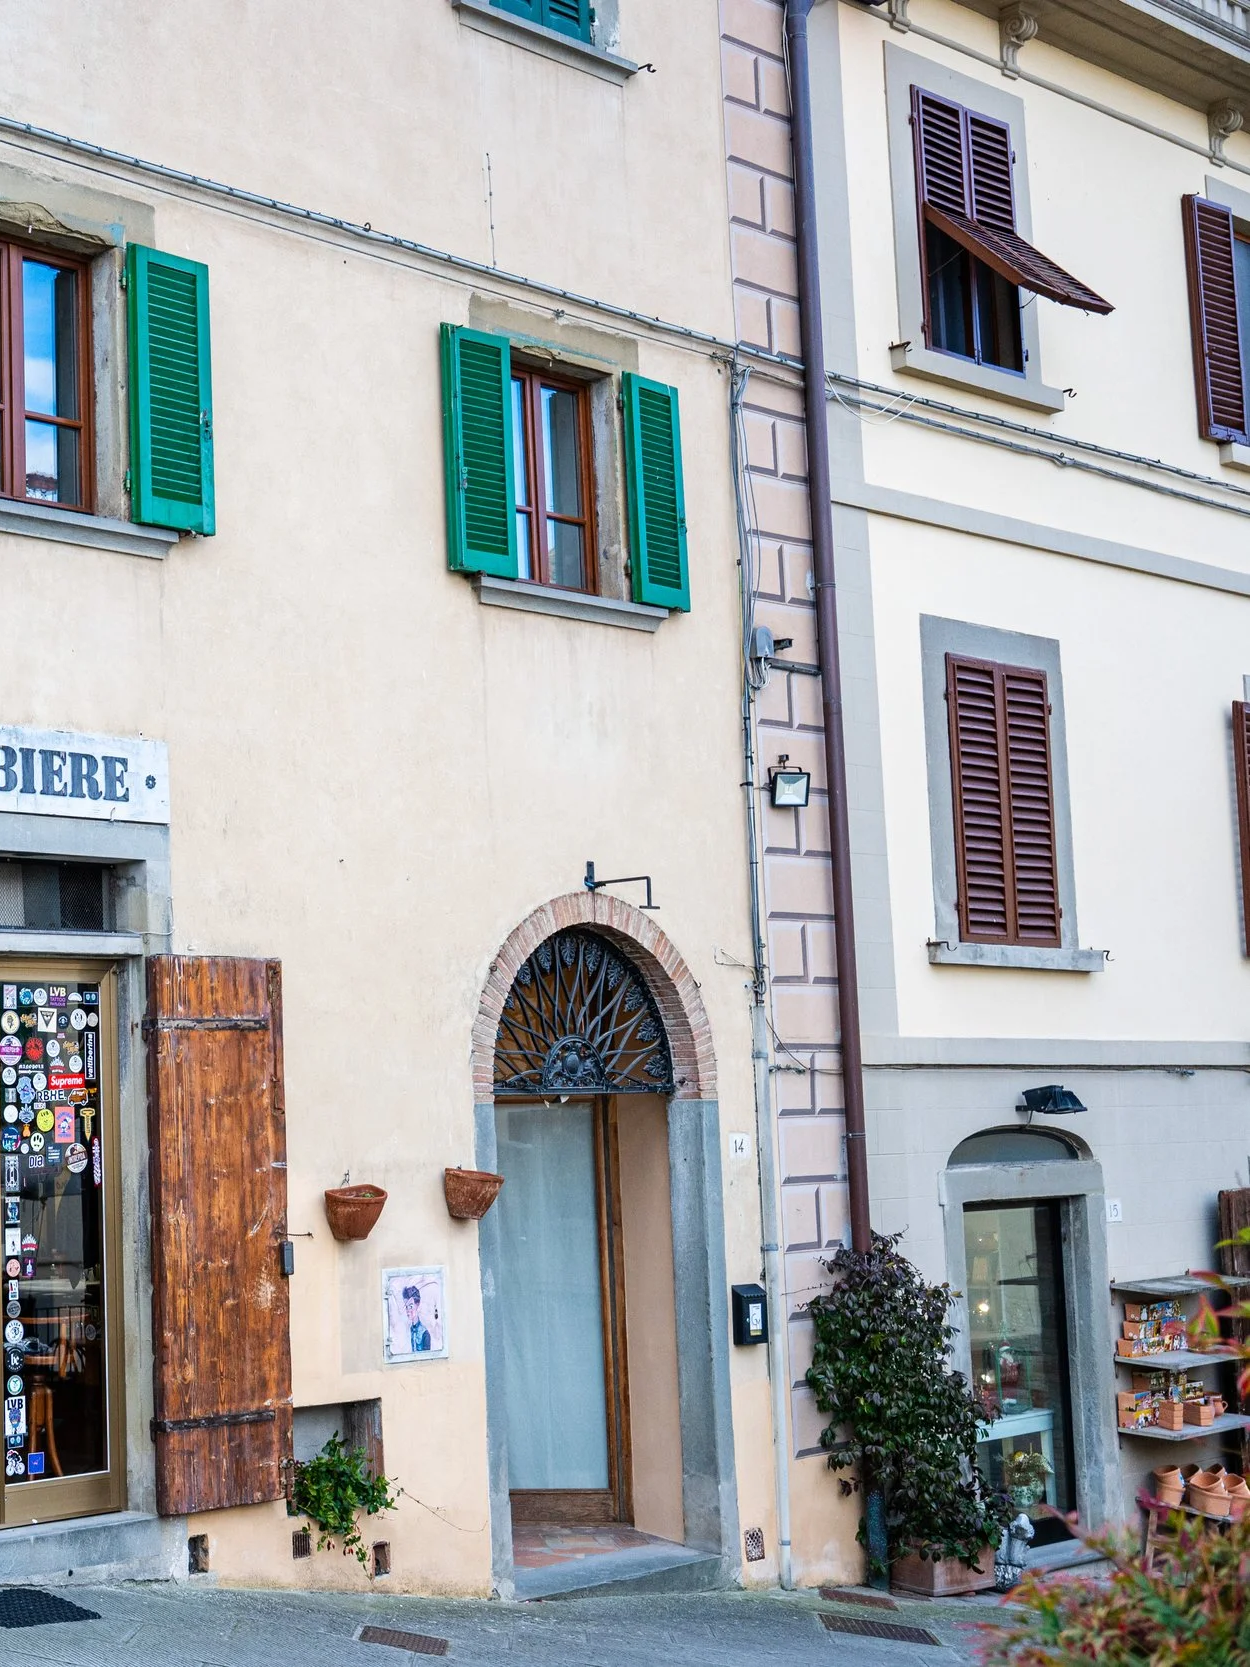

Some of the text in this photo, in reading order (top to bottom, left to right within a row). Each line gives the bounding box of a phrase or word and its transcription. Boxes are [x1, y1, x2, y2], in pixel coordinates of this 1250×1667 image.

[50, 986, 66, 998] LVB
[51, 1076, 83, 1088] Supreme
[734, 1138, 744, 1153] 14
[1110, 1203, 1119, 1218] 15
[7, 1399, 23, 1410] LVB
